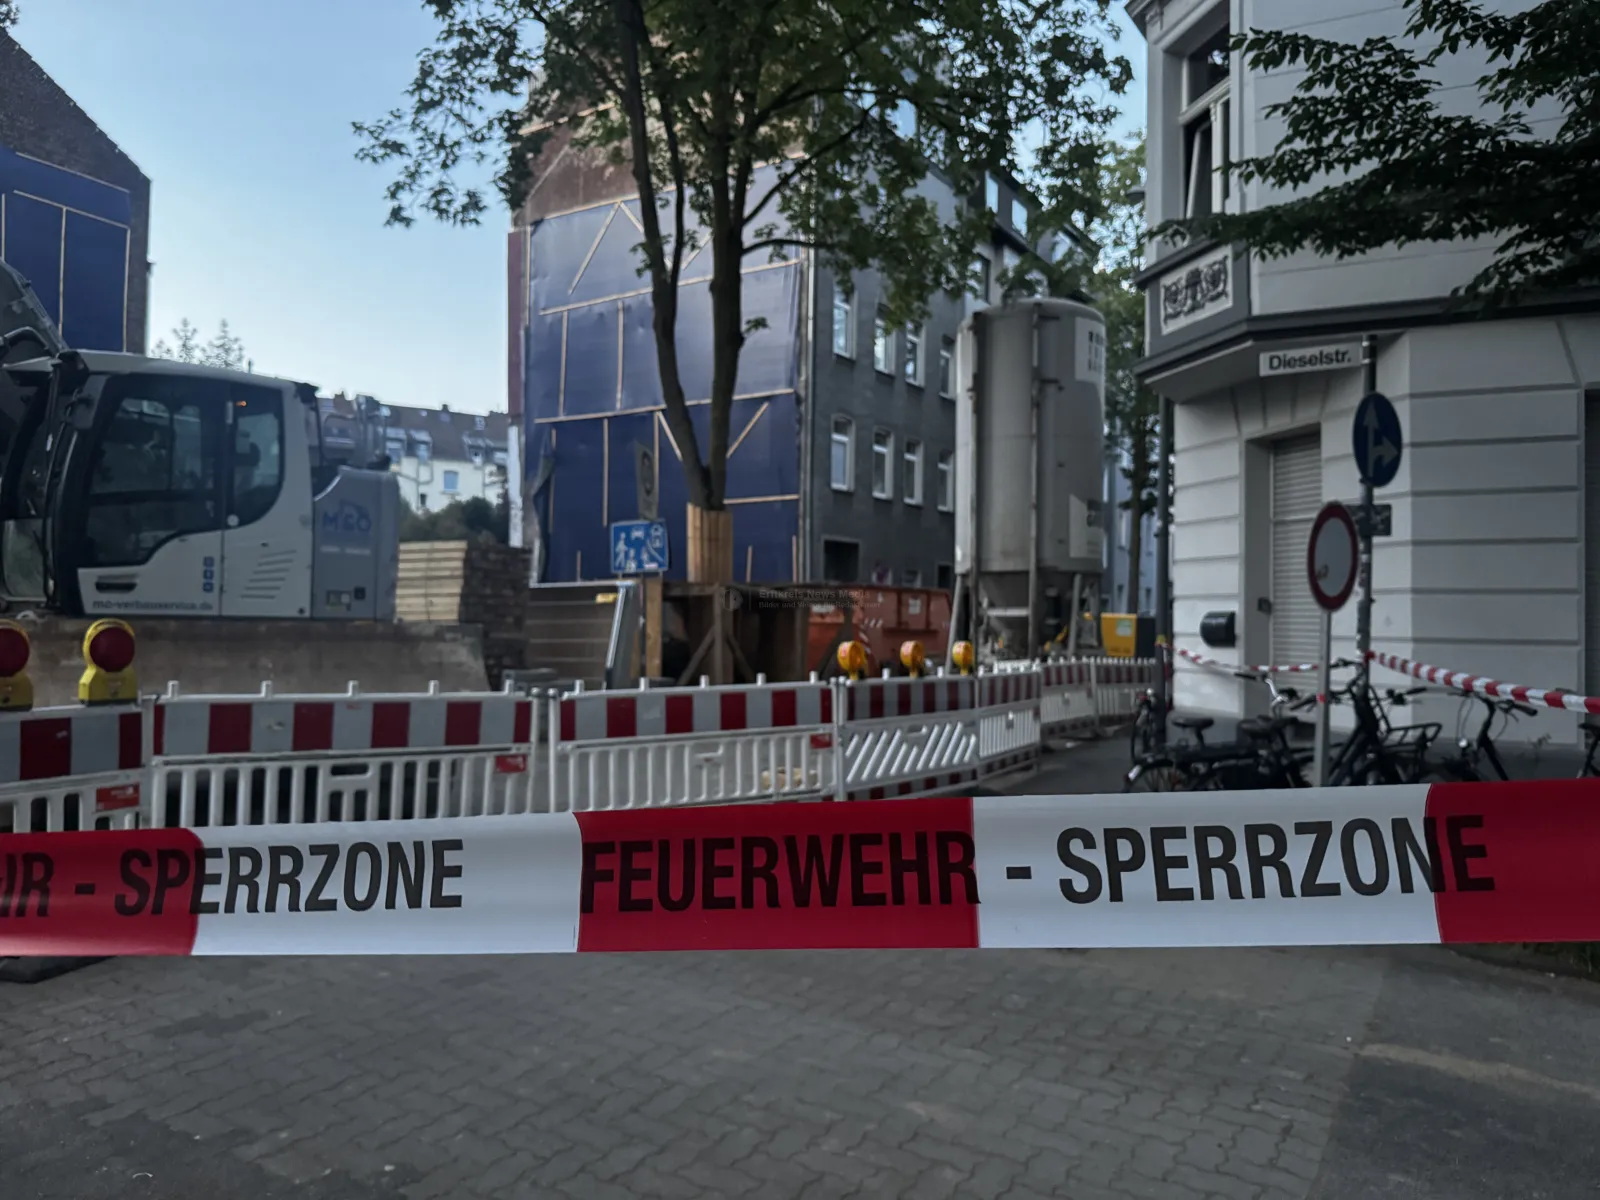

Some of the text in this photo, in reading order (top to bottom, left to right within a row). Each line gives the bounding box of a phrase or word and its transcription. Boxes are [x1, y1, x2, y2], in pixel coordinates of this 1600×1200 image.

[1268, 349, 1352, 371] Dieselstr.
[74, 881, 96, 895] -
[114, 838, 464, 918] SPERRZONE
[580, 814, 1496, 915] FEUERWEHR - SPERRZONE
